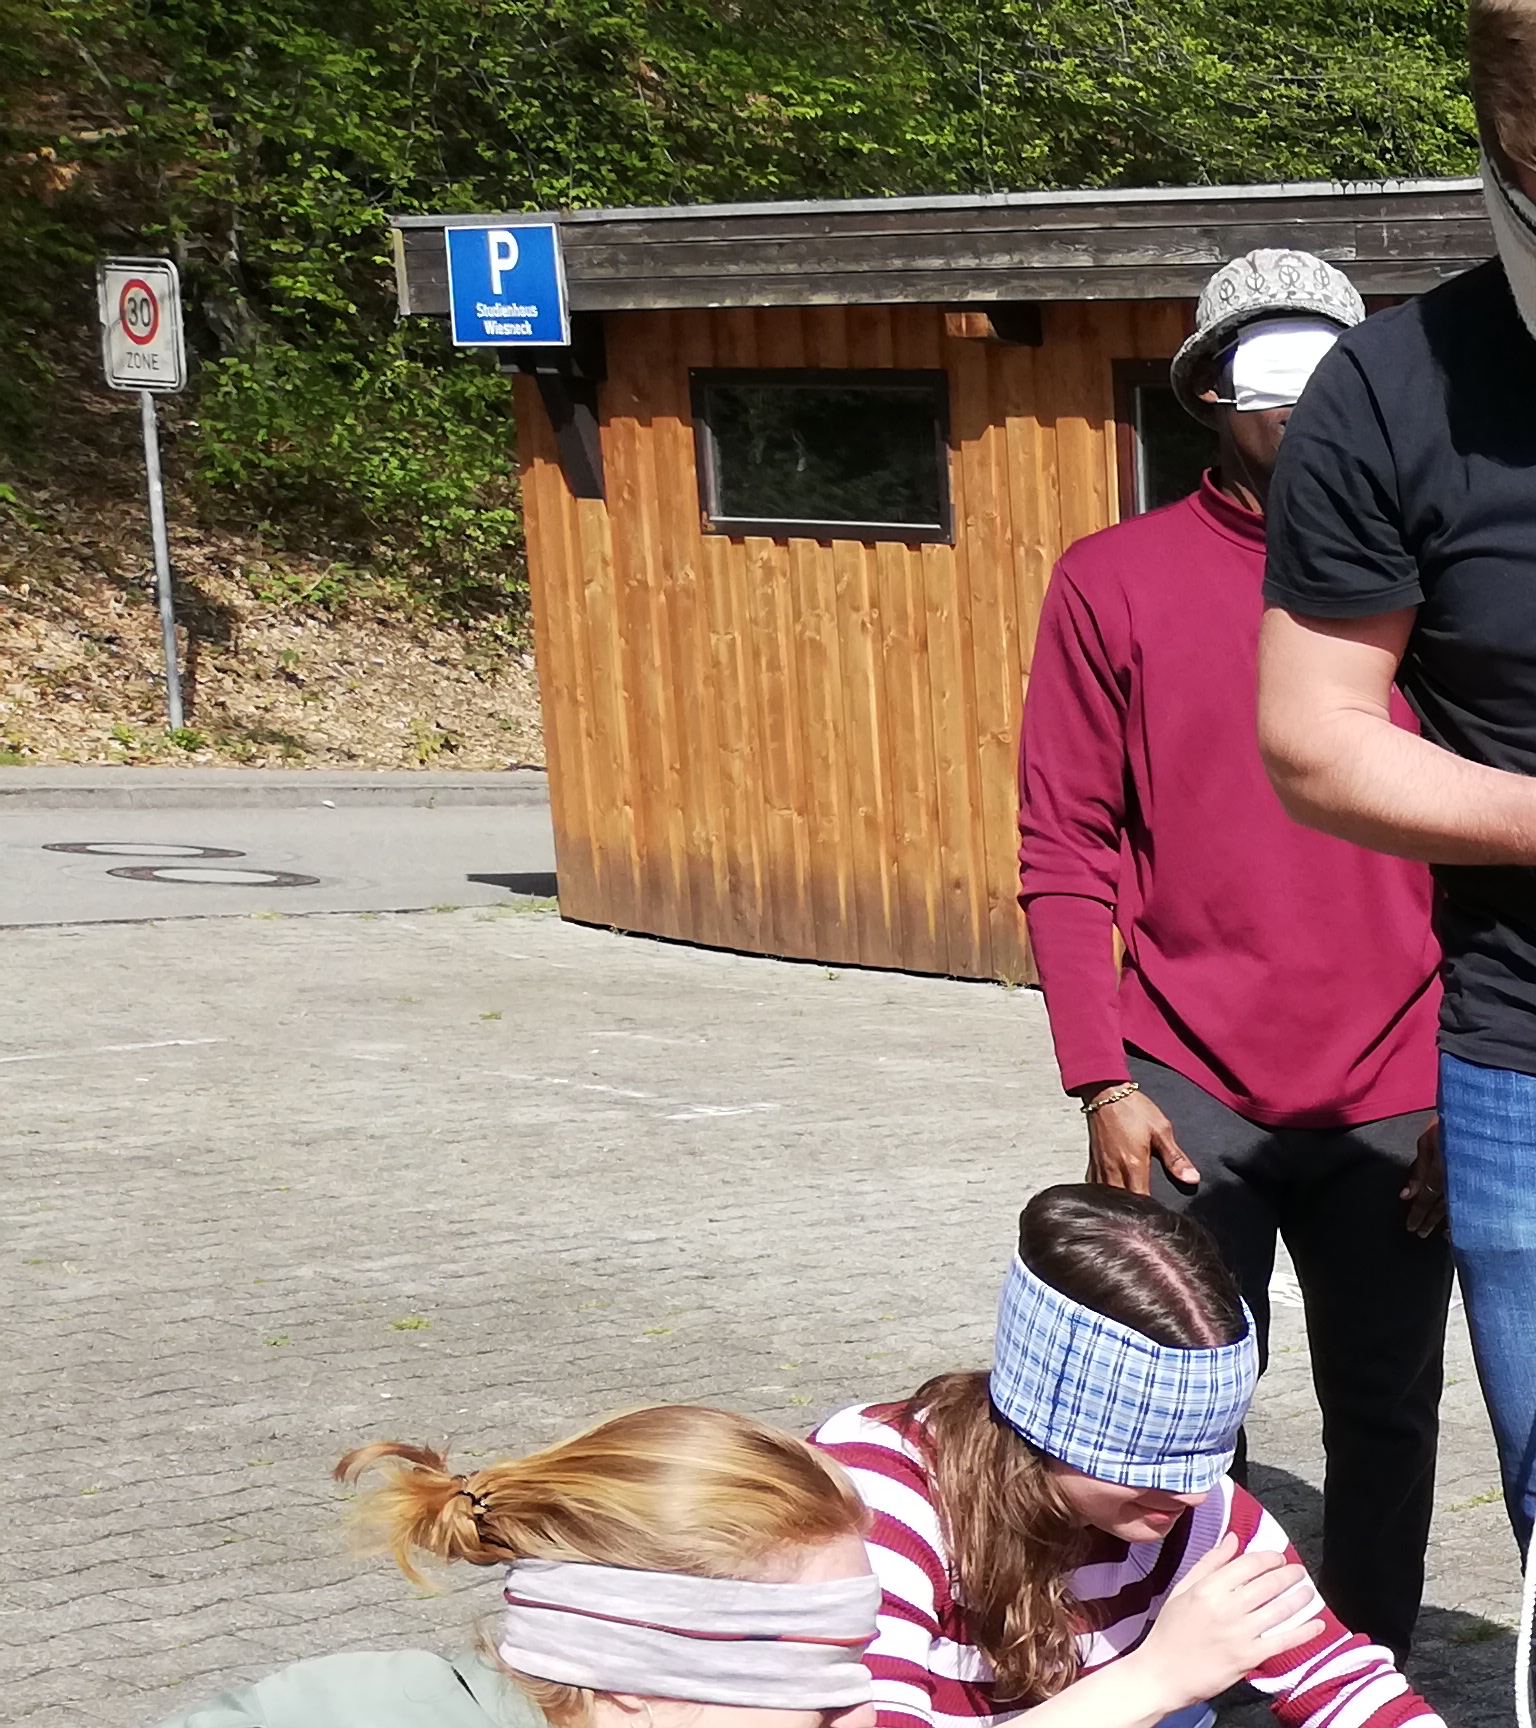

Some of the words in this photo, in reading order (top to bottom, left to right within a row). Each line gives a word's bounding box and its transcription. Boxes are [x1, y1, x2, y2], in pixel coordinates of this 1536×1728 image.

[487, 230, 519, 295] P
[127, 296, 152, 328] 30
[475, 302, 539, 318] Studienhaus
[483, 320, 533, 336] Wiesneck
[126, 351, 160, 370] ZONE
